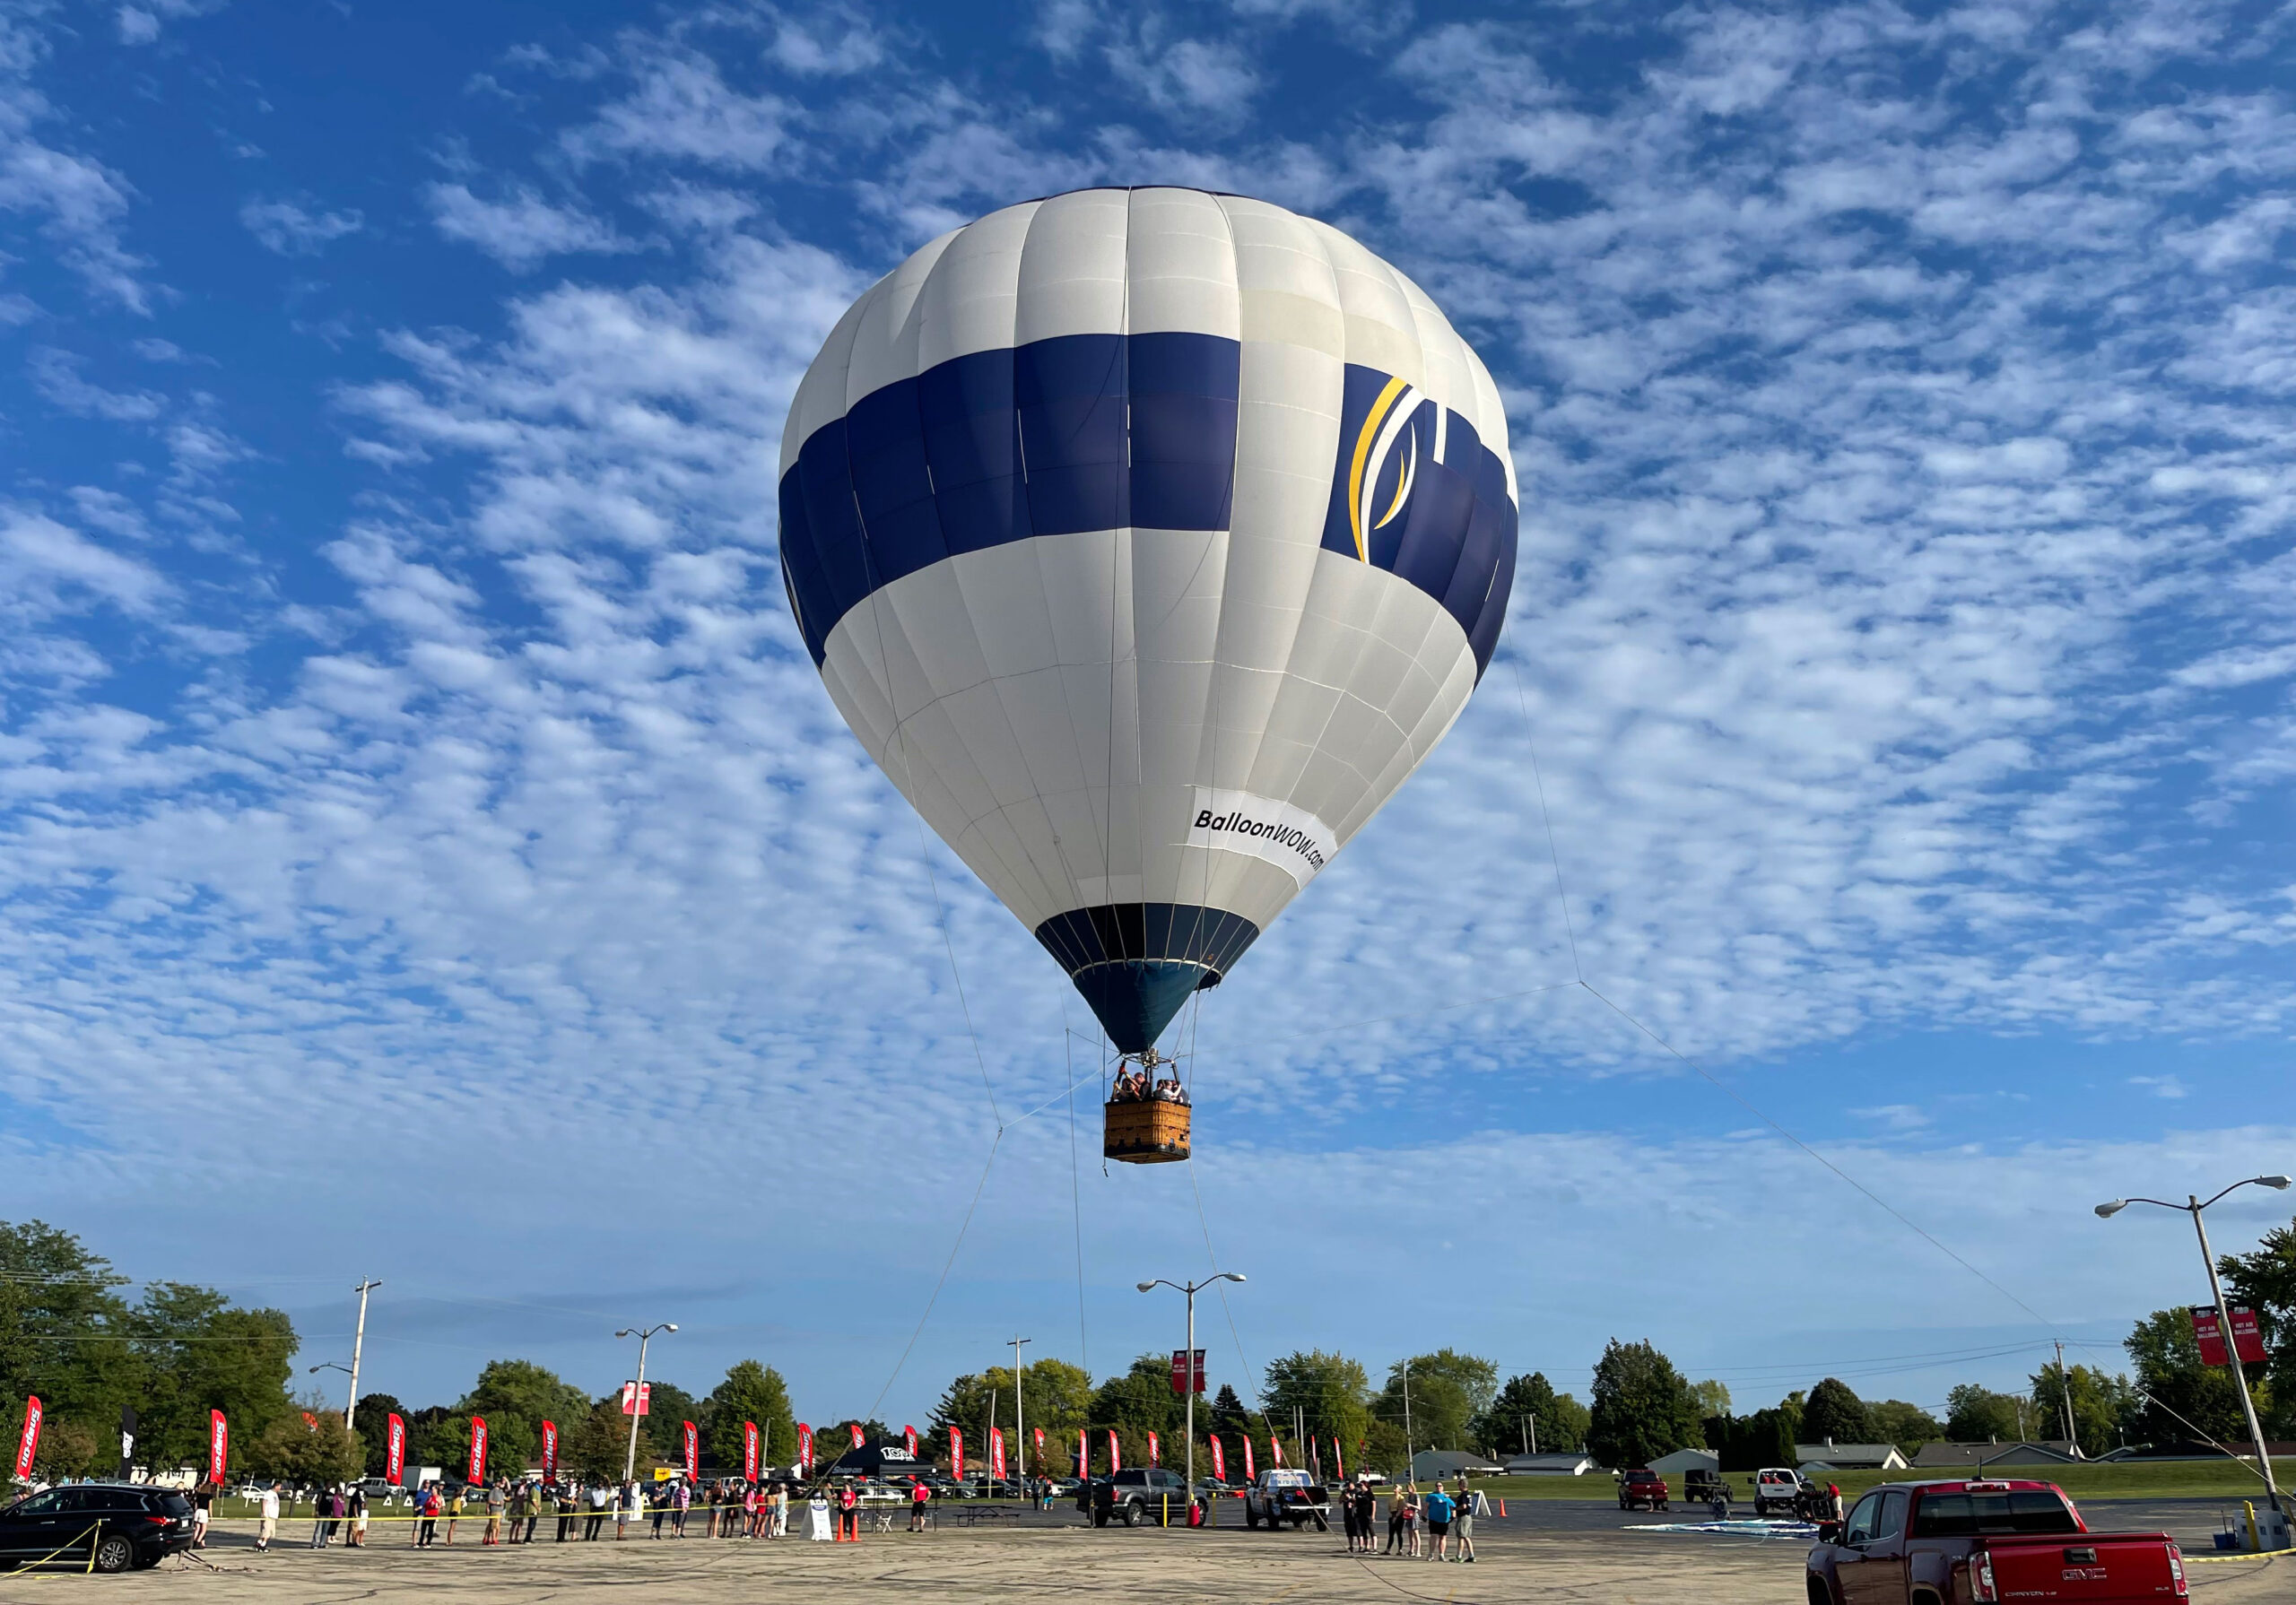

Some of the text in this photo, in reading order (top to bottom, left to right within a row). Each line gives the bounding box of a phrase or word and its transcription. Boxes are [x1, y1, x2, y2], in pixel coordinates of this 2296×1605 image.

[1194, 810, 1325, 872] BalloonWOW.com
[21, 1407, 40, 1468] Snap-on
[213, 1420, 225, 1476] Snap-on
[390, 1422, 403, 1476] Snap-on
[473, 1426, 485, 1477] Snap-on
[545, 1429, 555, 1478] Snap-on
[687, 1429, 696, 1474] Snap-on
[747, 1430, 757, 1474] Snap-on
[952, 1434, 961, 1473] Snap-on
[995, 1435, 1003, 1473] Snap-on
[1213, 1440, 1222, 1474] Snap-on
[831, 1465, 863, 1474] Snap-on
[2062, 1567, 2108, 1581] GMC
